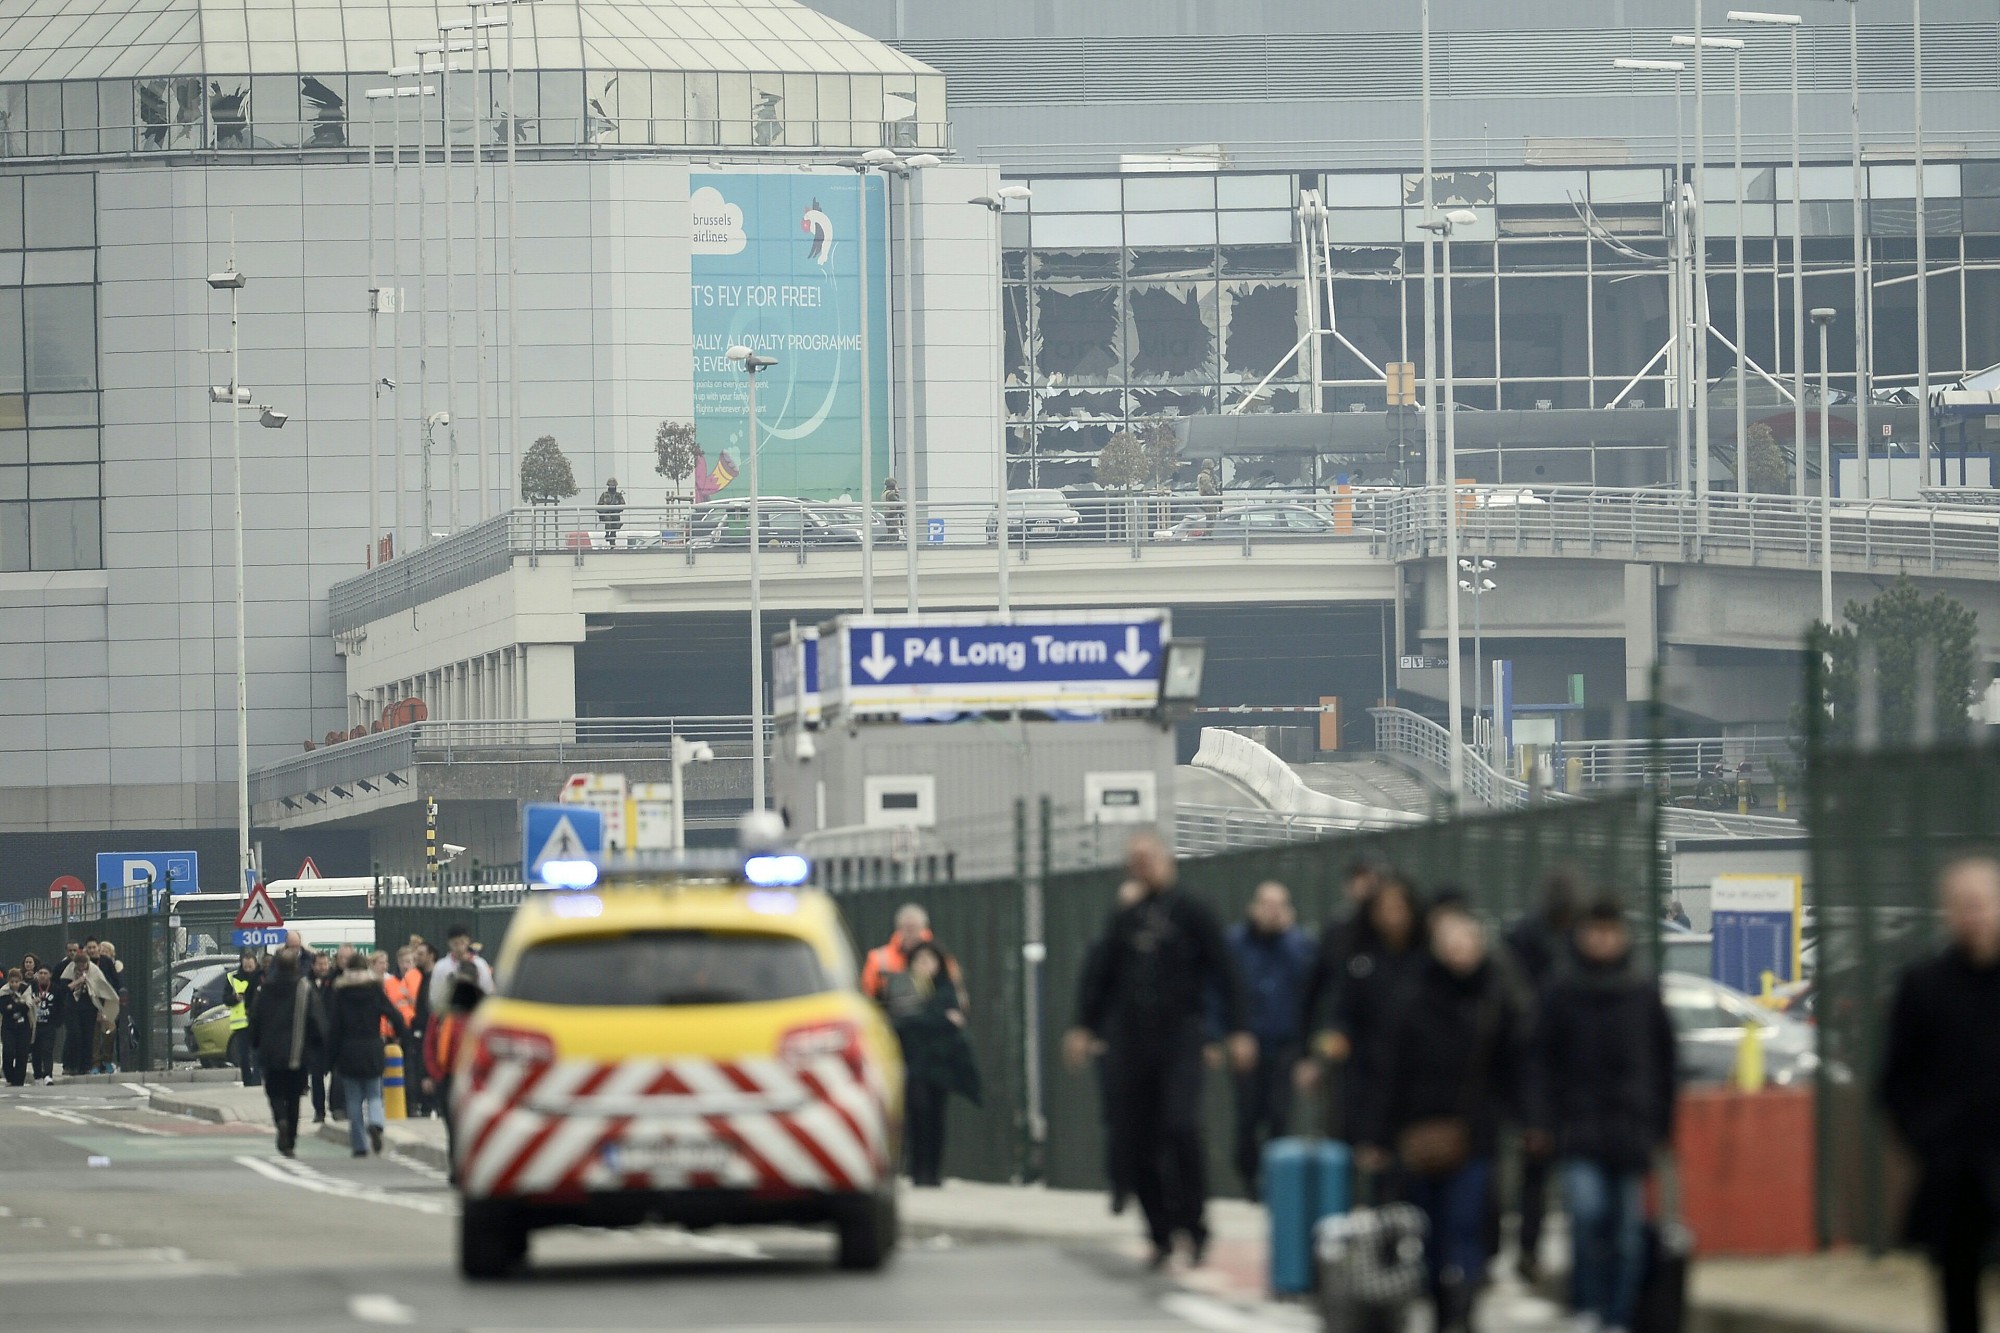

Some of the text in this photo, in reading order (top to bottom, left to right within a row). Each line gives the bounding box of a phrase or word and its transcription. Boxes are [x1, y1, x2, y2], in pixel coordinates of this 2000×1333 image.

[693, 213, 732, 226] brussels
[693, 230, 728, 242] airlines
[718, 285, 742, 306] FLY
[746, 285, 777, 306] FOR
[781, 285, 821, 307] FREE!
[788, 334, 862, 351] PROGRAMME
[696, 380, 713, 391] points
[723, 381, 737, 391] every
[698, 393, 705, 402] up
[707, 391, 718, 400] with
[719, 393, 732, 403] your
[714, 404, 741, 413] whenever
[929, 523, 943, 541] P
[904, 634, 1108, 672] P4 Long Term
[1402, 657, 1410, 668] P
[123, 860, 157, 909] P
[242, 931, 278, 945] 30 m
